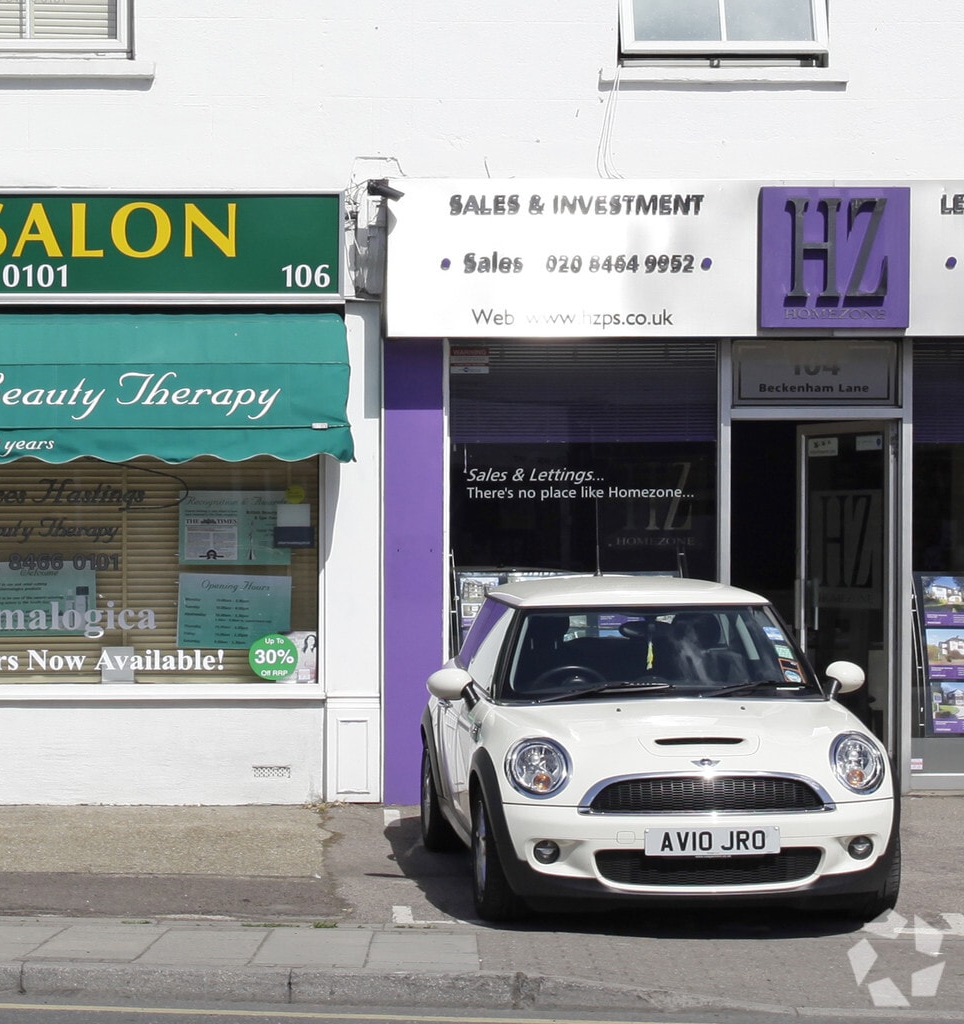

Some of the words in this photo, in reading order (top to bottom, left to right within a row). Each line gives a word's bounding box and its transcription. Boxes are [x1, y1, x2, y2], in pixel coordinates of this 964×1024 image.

[449, 194, 520, 215] SALES
[528, 194, 545, 215] &
[553, 194, 704, 215] INVESTMENT
[784, 198, 888, 304] HZ
[463, 252, 523, 273] Sales
[546, 255, 582, 273] 020
[2, 264, 68, 288] 0101
[281, 264, 331, 288] 106
[784, 308, 887, 320] HOMEZONE
[116, 371, 281, 420] Therapy
[759, 383, 834, 393] Beckenham
[838, 383, 869, 393] Lane
[0, 439, 54, 457] years
[467, 468, 507, 481] Sales
[512, 468, 525, 481] &
[529, 468, 604, 484] Lettings...
[32, 478, 146, 511] Hastings
[467, 487, 513, 498] There's
[518, 489, 536, 498] no
[540, 487, 576, 501] place
[581, 487, 604, 498] like
[608, 487, 694, 498] Homezone...
[38, 517, 118, 543] Therapy
[8, 553, 63, 570] 8466
[72, 553, 119, 570] 0101
[201, 579, 239, 592] Opening
[242, 580, 270, 591] Hours
[27, 650, 84, 671] Now
[94, 649, 225, 672] Available!
[254, 649, 294, 664] 30%
[661, 831, 713, 851] AV10
[721, 829, 766, 851] JRO
